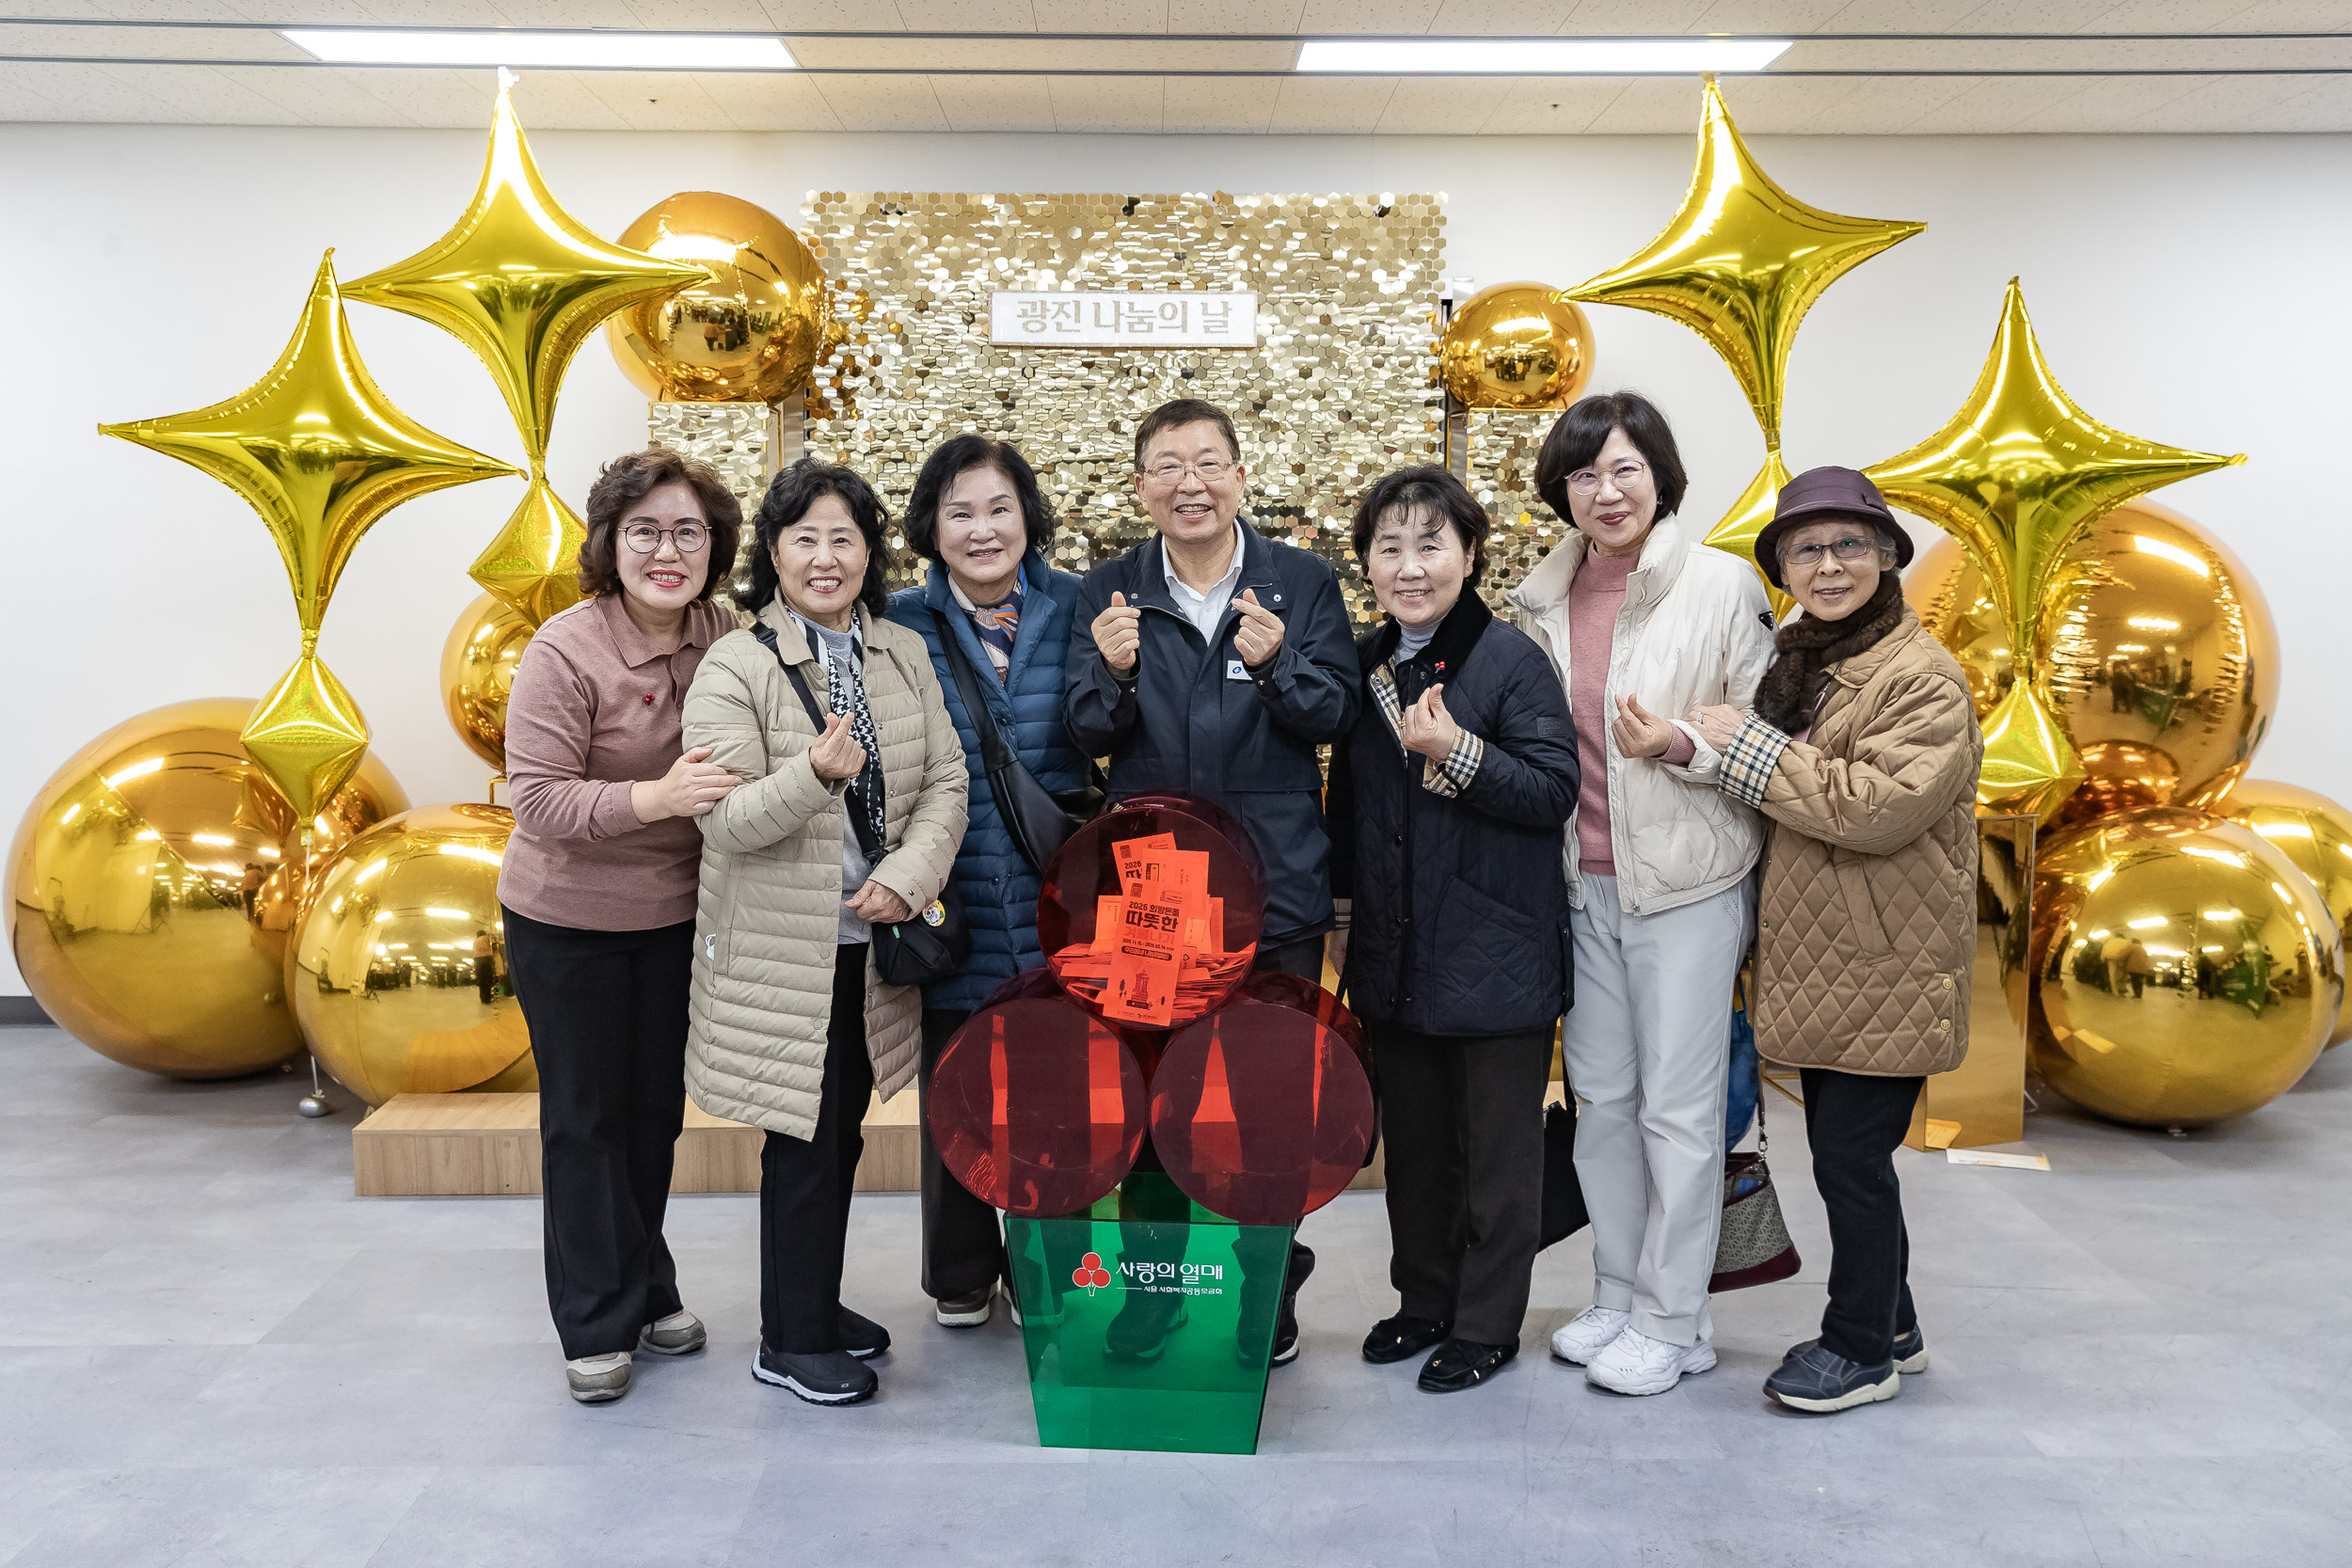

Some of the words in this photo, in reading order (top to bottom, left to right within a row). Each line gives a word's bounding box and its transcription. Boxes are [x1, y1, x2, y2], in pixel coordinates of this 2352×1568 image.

[1016, 299, 1081, 334] 광진
[1092, 300, 1188, 334] 나눔의
[1200, 301, 1232, 334] 날
[1129, 901, 1148, 911] 2026
[1125, 910, 1178, 933] 따뜻한
[1115, 1261, 1175, 1284] 사랑의
[1179, 1263, 1223, 1285] 열매
[1159, 1286, 1223, 1296] 사회복지공동모금회
